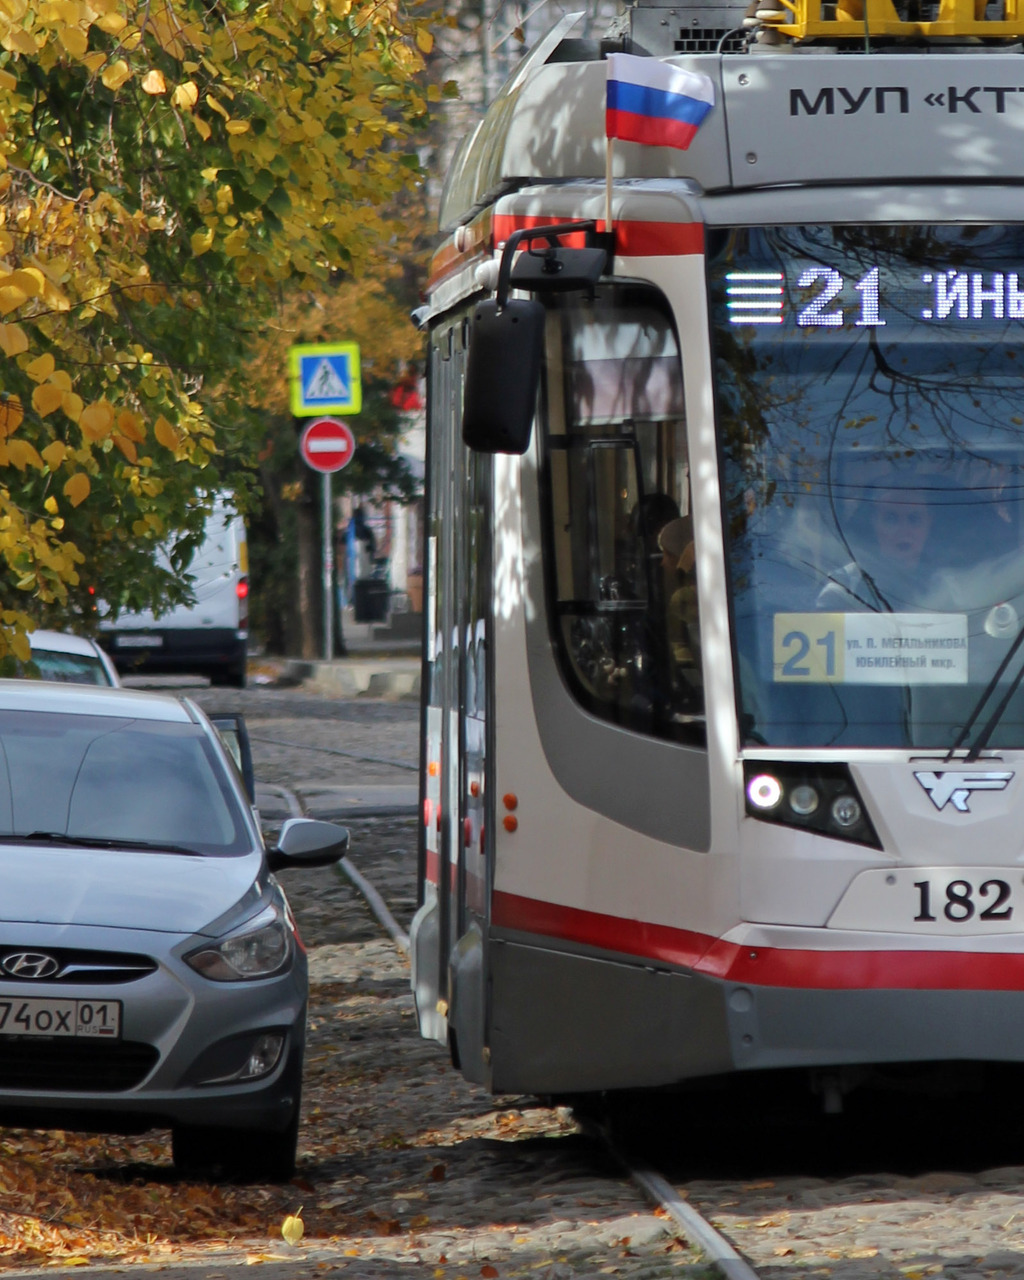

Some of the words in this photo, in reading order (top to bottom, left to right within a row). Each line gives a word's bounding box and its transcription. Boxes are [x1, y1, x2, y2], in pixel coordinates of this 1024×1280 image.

[789, 87, 909, 116] МУП
[797, 267, 887, 326] 21
[782, 631, 836, 676] 21
[881, 637, 967, 650] МЕТАЛЬНИКОВА
[856, 654, 927, 668] ЮБИЛЕЙНЫЙ
[914, 879, 1013, 922] 182
[80, 1004, 107, 1025] 01
[77, 1025, 98, 1034] RUS
